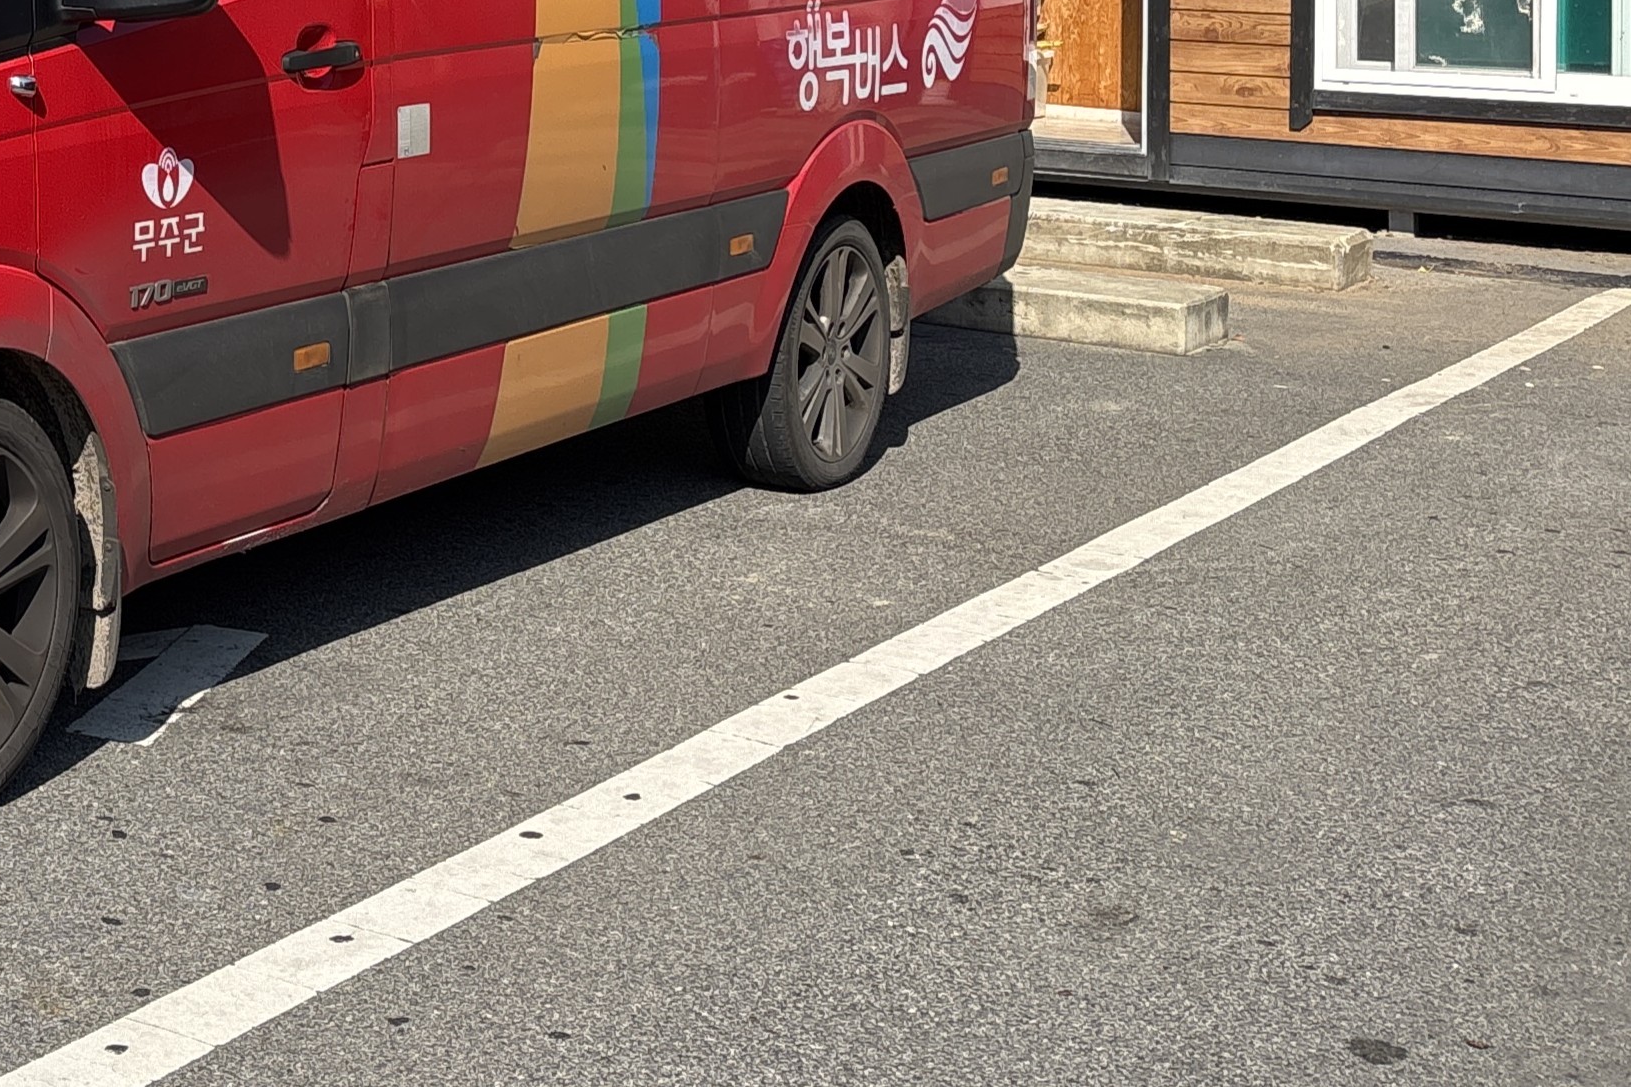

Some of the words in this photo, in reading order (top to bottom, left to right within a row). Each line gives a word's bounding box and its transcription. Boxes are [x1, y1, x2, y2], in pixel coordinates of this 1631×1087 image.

[786, 0, 909, 112] 행복버스
[133, 212, 206, 262] 무주군
[129, 279, 172, 309] 170
